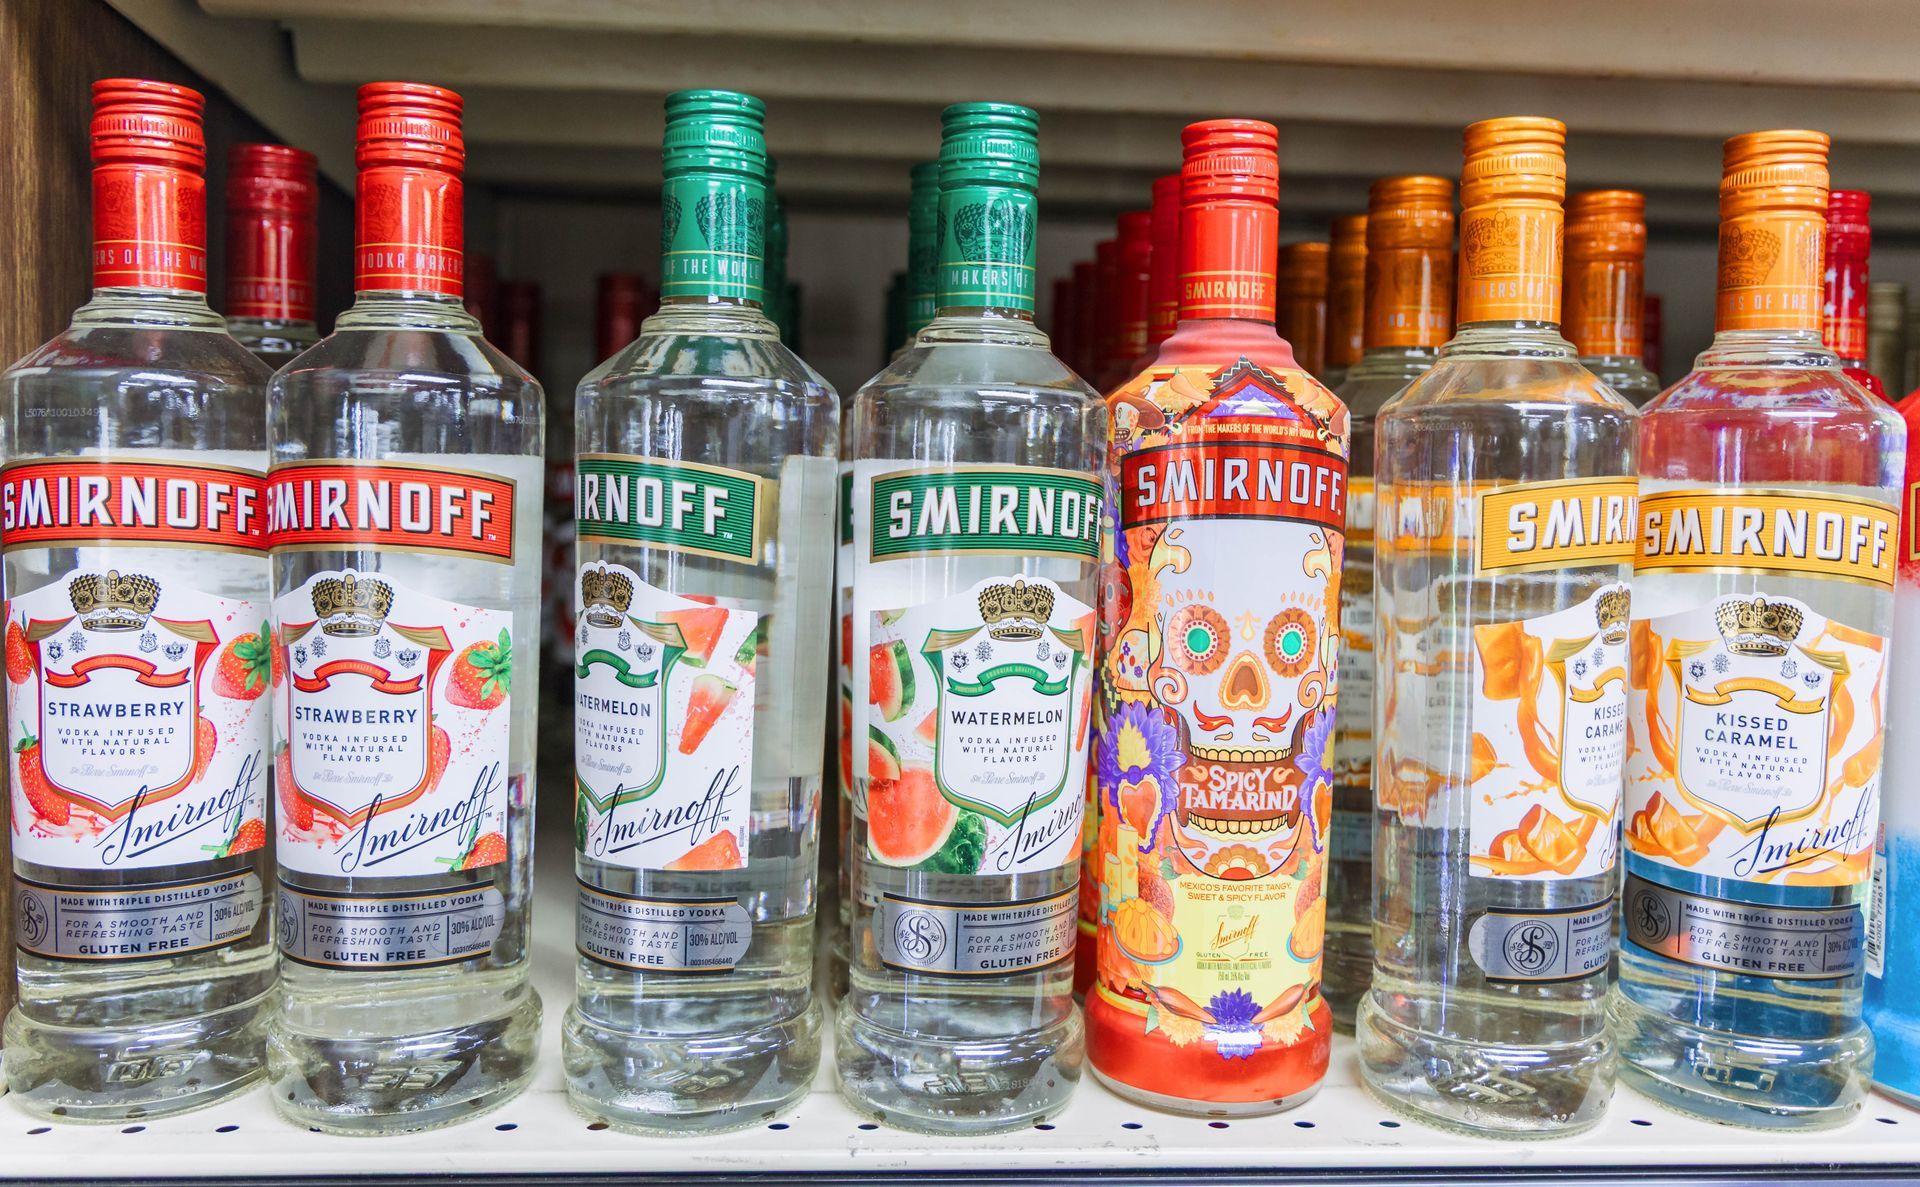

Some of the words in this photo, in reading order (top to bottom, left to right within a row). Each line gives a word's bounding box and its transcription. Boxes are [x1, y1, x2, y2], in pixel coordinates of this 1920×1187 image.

[154, 250, 181, 268] THE
[361, 252, 405, 268] VODKA
[683, 258, 708, 275] THE
[952, 269, 1008, 287] MAKERS
[1185, 281, 1266, 300] SMIRNOFF
[1754, 294, 1773, 310] OF
[1783, 293, 1808, 310] THE
[1205, 424, 1216, 434] THE
[1216, 424, 1241, 433] MAKERS
[1242, 424, 1250, 433] OF
[1251, 424, 1262, 434] THE
[1262, 424, 1288, 435] WORLD'S
[1137, 458, 1342, 512] SMIRNOFF
[4, 475, 257, 535] SMIRNOFF
[267, 480, 494, 540] SMIRNOFF
[1643, 505, 1889, 568] SMIRNOFF
[48, 701, 184, 718] STRAWBERRY
[577, 693, 651, 717] ATERMELON
[295, 706, 417, 724] STRAWBERRY
[951, 710, 1063, 726] WATERMELON
[1716, 712, 1788, 731] KISSED
[57, 727, 99, 736] VODKA
[110, 727, 175, 736] INFUSED
[302, 733, 338, 742] VODKA
[347, 734, 408, 743] INFUSED
[596, 732, 640, 745] NATURAL
[599, 724, 644, 735] INFUSED
[1704, 728, 1798, 749] CARAMEL
[61, 737, 93, 745] WITH
[103, 737, 170, 745] NATURAL
[305, 743, 333, 751] WITH
[341, 744, 404, 752] NATURAL
[585, 739, 622, 752] FLAVORS
[1010, 734, 1057, 744] INFUSED
[82, 747, 146, 755] FLAVORS
[323, 754, 381, 762] FLAVORS
[963, 745, 994, 753] WITH
[1004, 744, 1054, 754] NATURAL
[1696, 746, 1738, 759] VODKA
[1748, 753, 1808, 765] INFUSED
[983, 754, 1037, 763] FLAVORS
[1699, 756, 1731, 767] WITH
[1741, 762, 1803, 773] NATURAL
[1208, 765, 1274, 794] SPICY
[1720, 768, 1781, 781] FLAVORS
[1179, 782, 1298, 812] TAMARIND
[94, 750, 261, 866] Smirnoff
[333, 761, 502, 873] Smirnoff
[591, 765, 743, 857] Smirnoff
[1727, 784, 1874, 877] Smirnoff
[61, 897, 84, 906] MADE
[87, 898, 110, 907] WITH
[113, 896, 151, 906] TRIPLE
[155, 888, 210, 903] DISTILLED
[214, 880, 245, 894] VODKA
[1179, 881, 1221, 892] MEXICO'S
[1222, 883, 1264, 892] FAVORITE
[308, 901, 328, 911] MADE
[331, 904, 351, 912] WITH
[353, 904, 388, 913] TRIPLE
[392, 900, 446, 912] DISTILLED
[450, 894, 484, 906] VODKA
[1187, 892, 1217, 901] SWEET
[1218, 893, 1225, 901] &
[1227, 893, 1253, 902] SPICY
[1254, 892, 1286, 901] FLAVOR
[606, 902, 632, 913] TRIPLE
[635, 907, 685, 917] DISTILLED
[689, 908, 725, 917] VODKA
[991, 913, 1011, 921] WITH
[1013, 908, 1040, 919] TRIPLE
[1042, 899, 1070, 914] DISTILLED
[1686, 903, 1709, 915] MADE
[1713, 908, 1735, 919] WITH
[1738, 912, 1773, 924] TRIPLE
[1777, 917, 1826, 926] DISTILLED
[66, 919, 88, 929] FOR
[95, 920, 103, 928] A
[110, 916, 168, 928] SMOOTH
[176, 911, 204, 922] AND
[451, 922, 470, 935] 30%
[1573, 916, 1590, 926] MADE
[66, 928, 154, 939] REFRESHING
[162, 920, 204, 934] TASTE
[312, 924, 332, 934] FOR
[351, 926, 405, 936] SMOOTH
[412, 923, 441, 933] AND
[581, 924, 634, 946] REFRESHING
[641, 939, 679, 949] TASTE
[603, 923, 646, 938] SMOOTH
[652, 931, 679, 940] AND
[689, 933, 709, 946] 30%
[710, 931, 739, 945] ALC/VOL
[968, 935, 991, 944] FOR
[996, 935, 1003, 943] A
[1009, 927, 1050, 941] SMOOTH
[1053, 920, 1067, 932] AND
[1211, 914, 1260, 951] Smirnoff
[1689, 925, 1713, 937] FOR
[1734, 934, 1788, 947] SMOOTH
[1794, 939, 1819, 948] AND
[78, 943, 141, 955] GLUTEN
[149, 937, 189, 951] FREE
[312, 933, 391, 945] REFRESHING
[400, 933, 440, 944] TASTE
[968, 939, 1041, 953] REFRESHING
[1045, 930, 1067, 944] TASTE
[1575, 937, 1591, 947] FOR
[1594, 935, 1599, 943] A
[1689, 934, 1774, 955] REFRESHING
[1782, 948, 1818, 957] TASTE
[323, 950, 379, 962] GLUTEN
[386, 949, 426, 960] FREE
[586, 941, 624, 960] GLUTEN
[629, 953, 664, 965] FREE
[980, 955, 1032, 969] GLUTEN
[1036, 947, 1060, 962] FREE
[1702, 951, 1762, 969] GLUTEN
[1768, 961, 1805, 972] FREE
